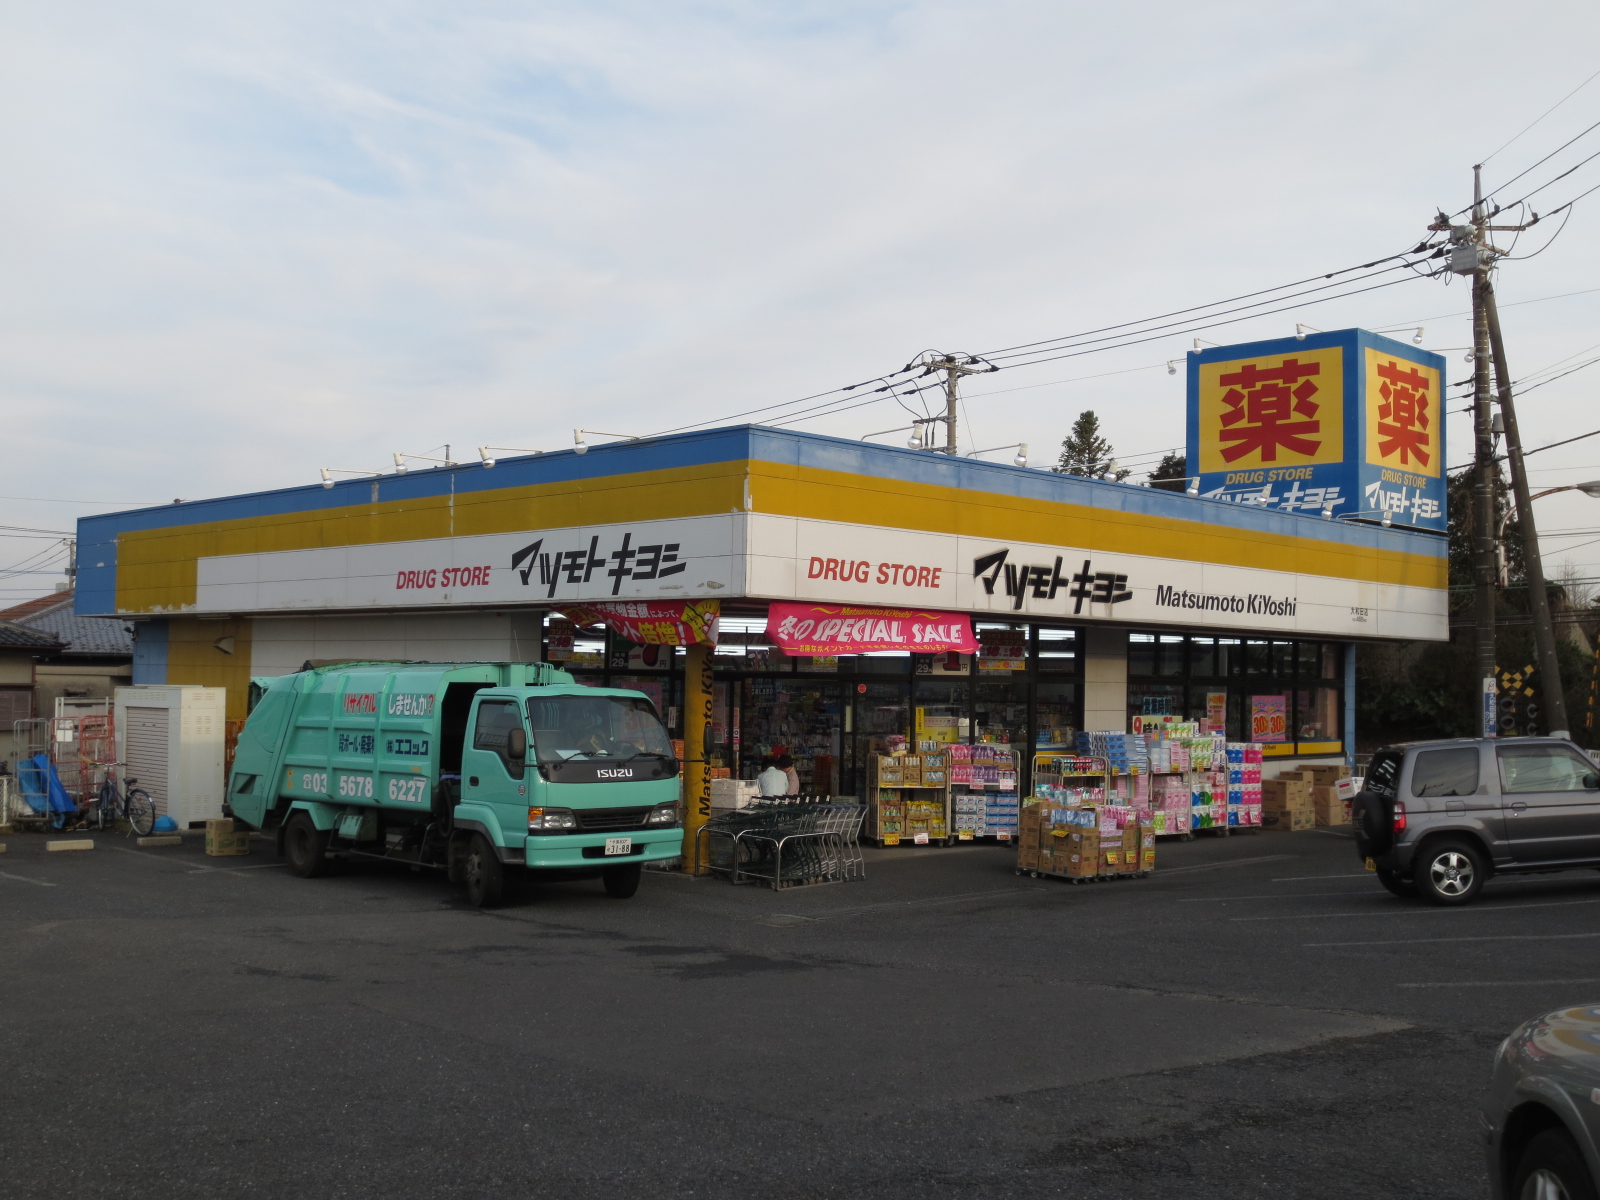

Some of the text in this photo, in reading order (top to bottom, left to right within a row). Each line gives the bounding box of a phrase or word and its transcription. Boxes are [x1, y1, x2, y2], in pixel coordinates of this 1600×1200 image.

[1219, 358, 1322, 464] 薬
[1376, 360, 1431, 468] 薬
[1225, 467, 1314, 485] DRUG STORE
[1381, 468, 1427, 489] DRUG STORE
[1365, 480, 1442, 524] マツモトキヨシ
[395, 565, 491, 590] DRUG STORE
[511, 532, 687, 598] マツモトキヨシ
[807, 556, 942, 589] DRUG STORE
[972, 547, 1133, 615] マツモトキヨシ
[839, 607, 913, 619] Matsumoto KiYoshi
[1155, 584, 1297, 617] Matsumoto KiYoshi
[777, 615, 963, 645] 冬の SPECIAL SALE
[343, 692, 435, 716] リサイクル しませんか?
[313, 772, 427, 803] 03 5678 6227
[596, 768, 633, 778] ISUZU
